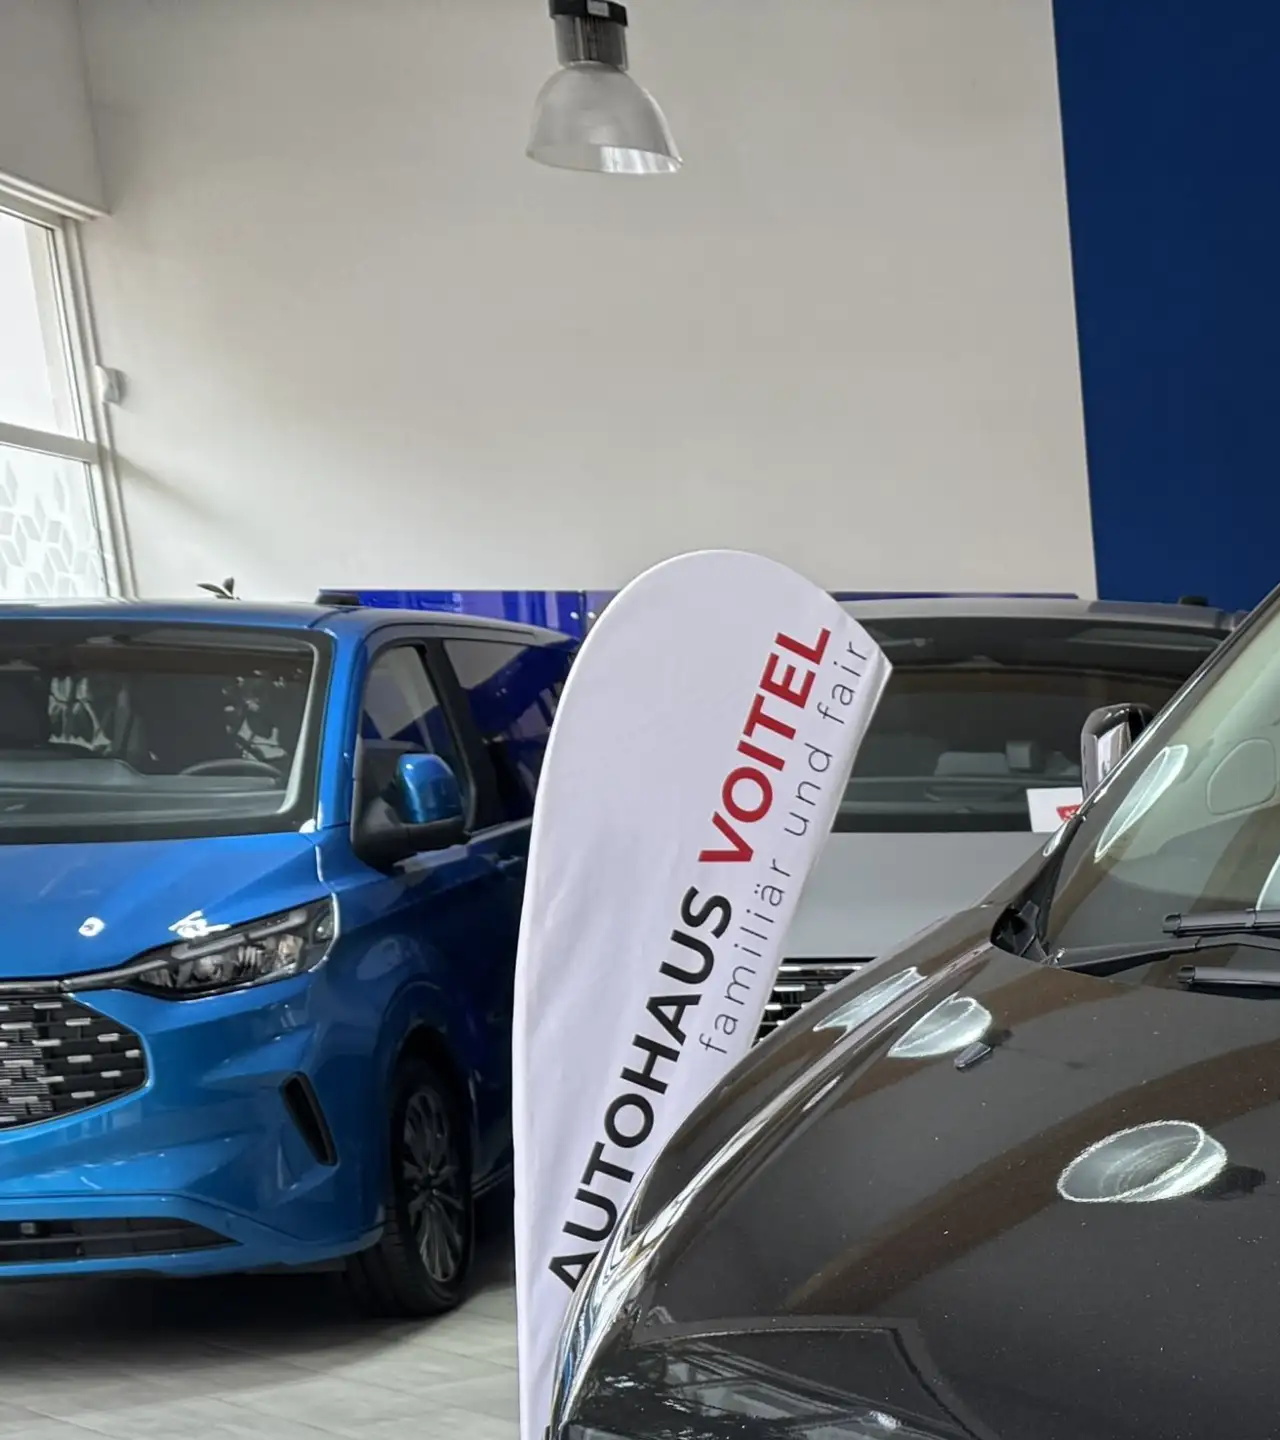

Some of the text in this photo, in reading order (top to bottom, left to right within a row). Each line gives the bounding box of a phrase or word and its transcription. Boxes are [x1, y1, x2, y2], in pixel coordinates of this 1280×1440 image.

[548, 626, 831, 1294] AUTOHAUS VOITEL
[699, 641, 869, 1055] familiär und fair
